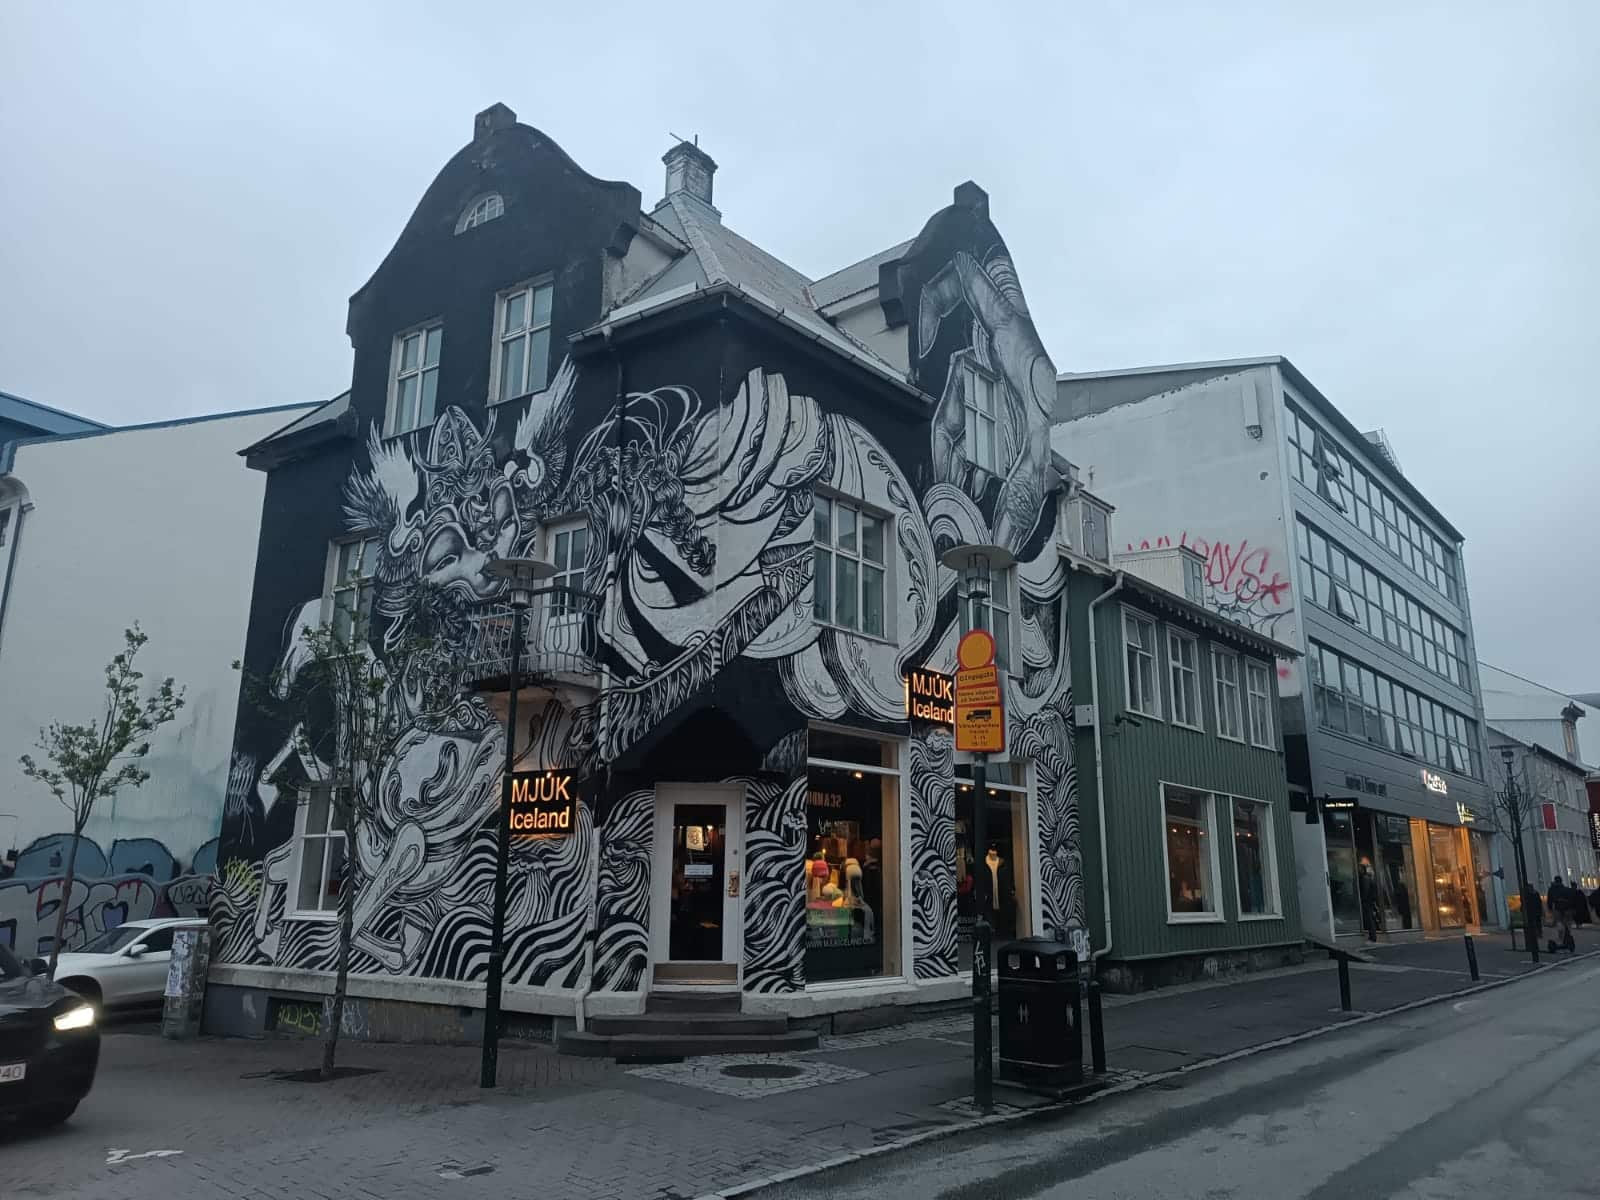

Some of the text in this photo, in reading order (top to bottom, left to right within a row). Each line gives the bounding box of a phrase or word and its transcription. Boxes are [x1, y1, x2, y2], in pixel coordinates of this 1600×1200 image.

[912, 672, 953, 701] MJÚK
[912, 697, 954, 724] Iceland
[511, 772, 571, 803] MJÚK
[509, 806, 570, 829] Iceland
[0, 1066, 21, 1079] 40
